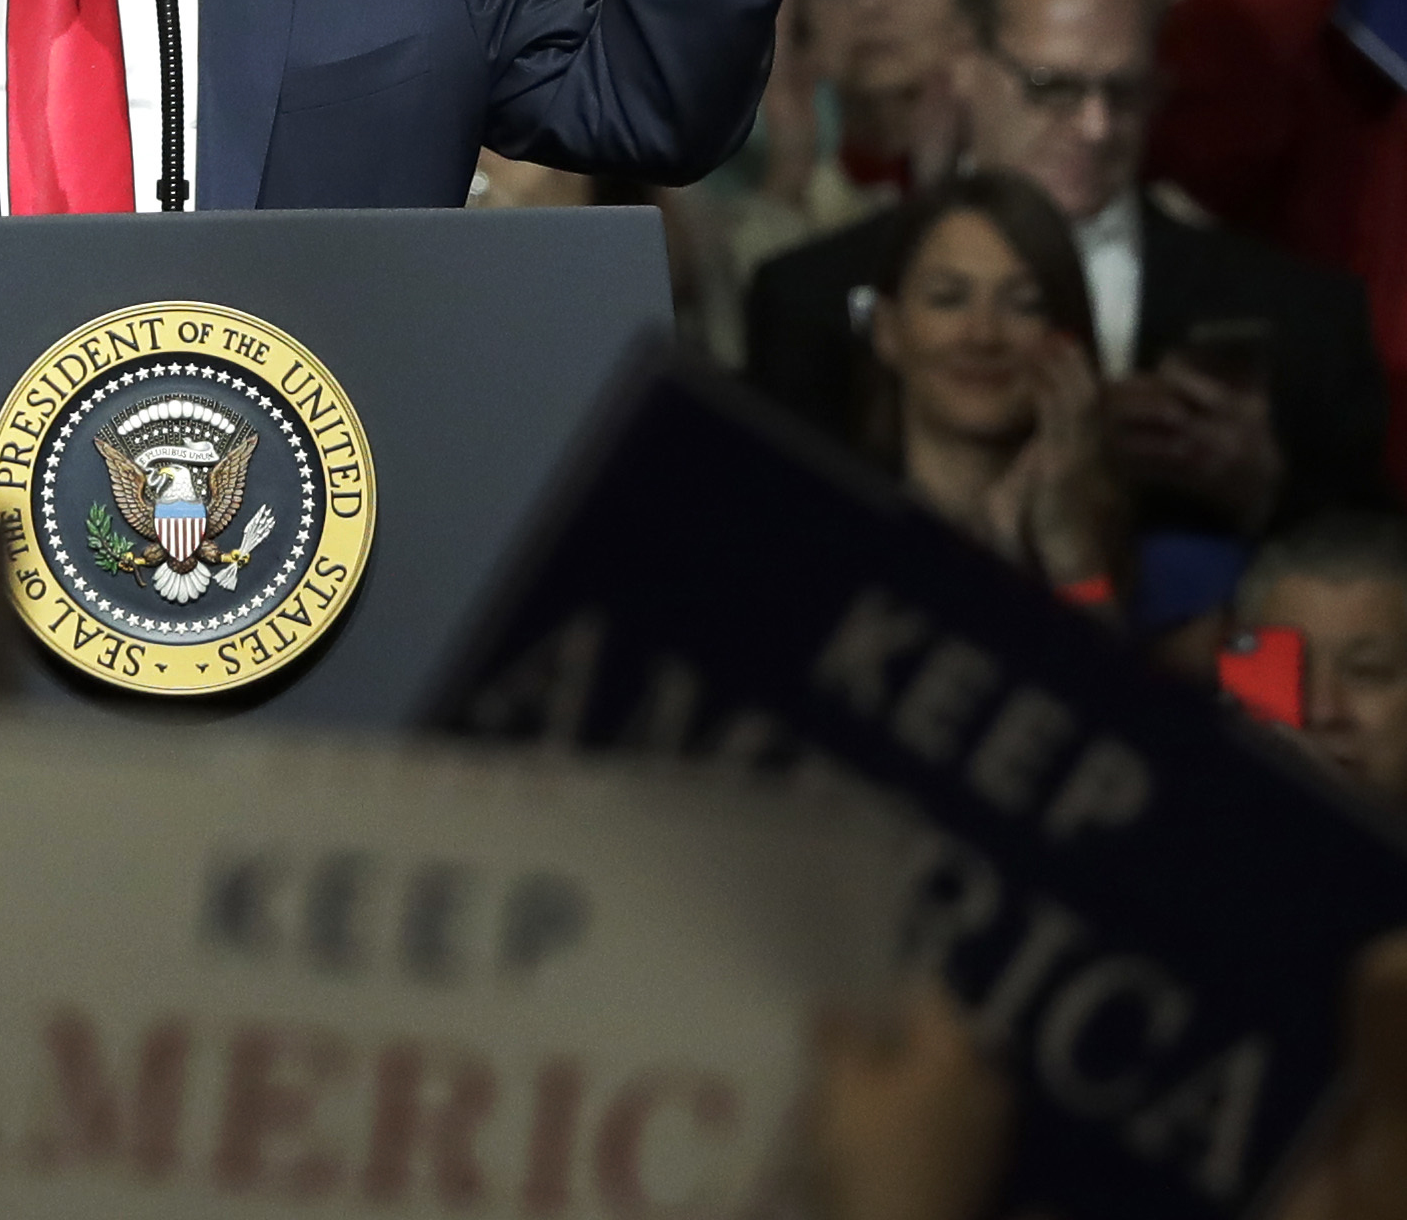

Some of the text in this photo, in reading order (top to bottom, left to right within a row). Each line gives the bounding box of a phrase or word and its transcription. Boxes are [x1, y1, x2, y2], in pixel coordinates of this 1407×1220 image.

[178, 321, 214, 345] OF
[223, 327, 271, 365] THE
[145, 448, 187, 459] PLURIBUS
[280, 359, 363, 519] UNITED
[0, 507, 29, 562] THE
[15, 568, 47, 600] OF
[217, 555, 348, 676] STATES
[46, 596, 147, 677] SEAL
[804, 588, 1156, 842] KEEP
[198, 846, 598, 990] KEEP
